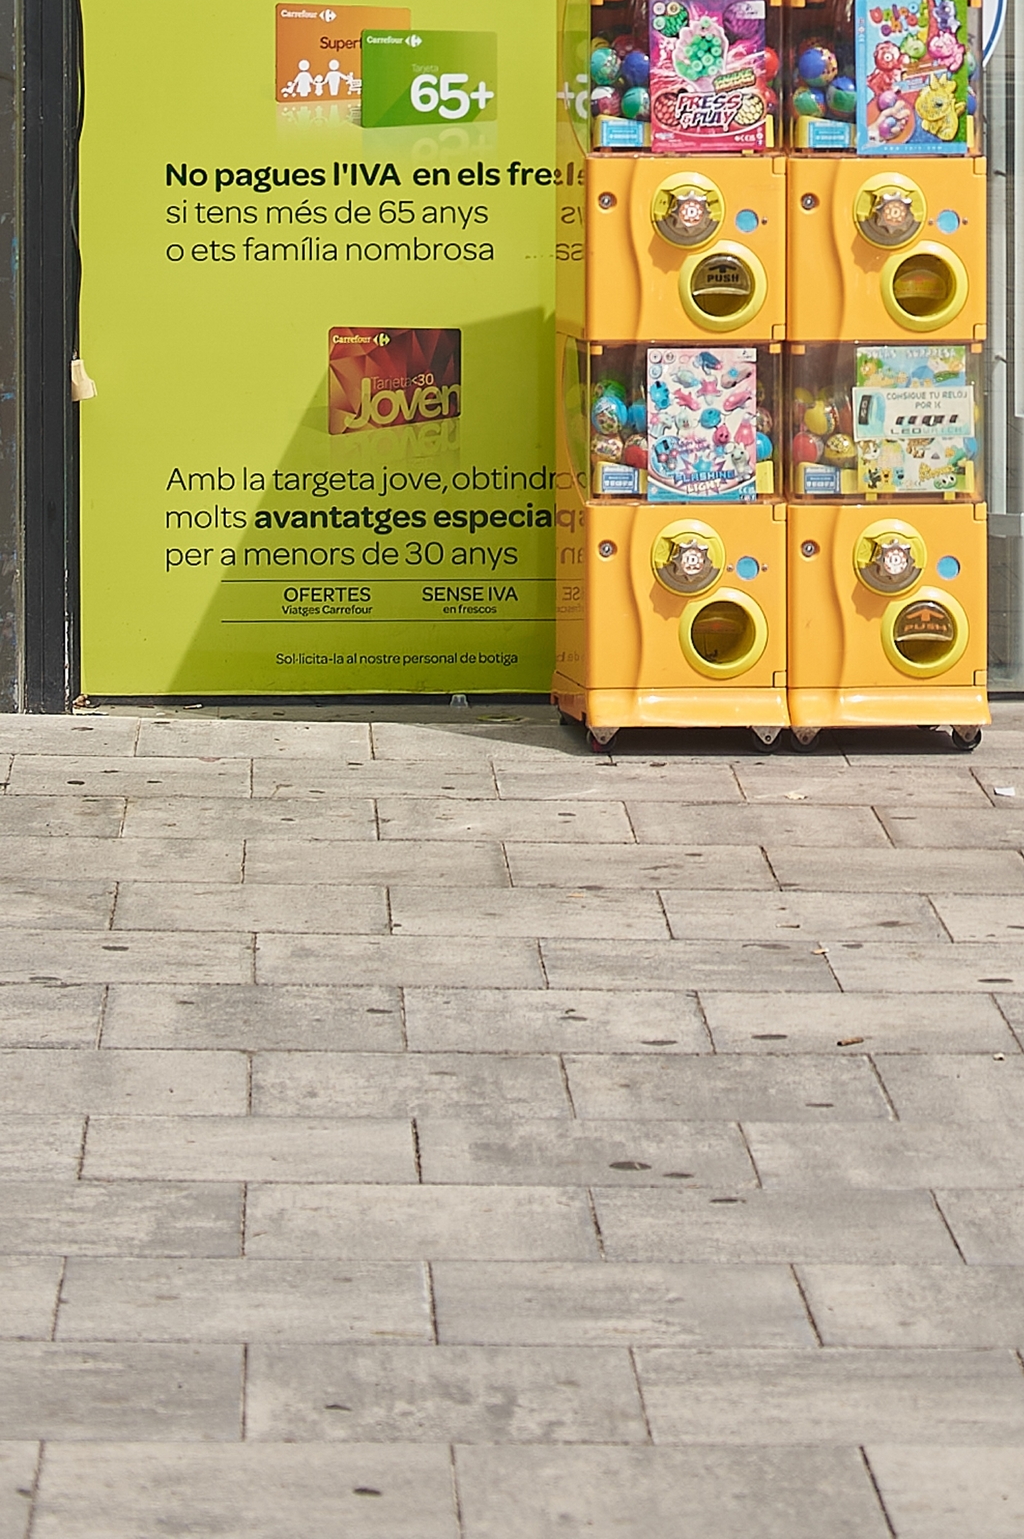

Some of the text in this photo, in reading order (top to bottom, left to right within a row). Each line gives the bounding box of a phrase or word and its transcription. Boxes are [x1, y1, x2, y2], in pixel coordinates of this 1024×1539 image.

[281, 9, 318, 19] Carrefour
[366, 35, 403, 45] Carrefour
[410, 73, 494, 119] 65+
[676, 92, 741, 113] PRESS
[166, 161, 556, 192] No pagues l'IVA en els fre
[166, 200, 488, 231] si tens més de 65 anys
[166, 237, 494, 262] o ets família nombrosa
[707, 274, 739, 283] PUSH
[332, 334, 371, 344] Carrefour
[371, 375, 412, 391] Tarjeta
[344, 377, 460, 429] Joven
[886, 391, 968, 401] CONSIGUE TU RELOJ
[915, 401, 932, 410] POR
[166, 466, 236, 491] Amb
[244, 466, 264, 491] la
[273, 469, 374, 498] targeta
[378, 466, 449, 498] jove,
[686, 479, 722, 493] LIGHT
[166, 505, 248, 529] molts
[254, 507, 426, 536] avantatges
[166, 541, 519, 573] per a menors de 30 anys
[283, 587, 372, 603] OFERTES
[421, 586, 519, 602] SENSE IVA
[281, 605, 374, 617] Viatges Carrefour
[443, 604, 498, 614] en frescos
[904, 622, 947, 633] PUSH
[347, 653, 358, 665] al
[359, 653, 401, 665] nostre
[402, 652, 457, 667] personal
[460, 652, 477, 664] de
[478, 652, 519, 667] botiga
